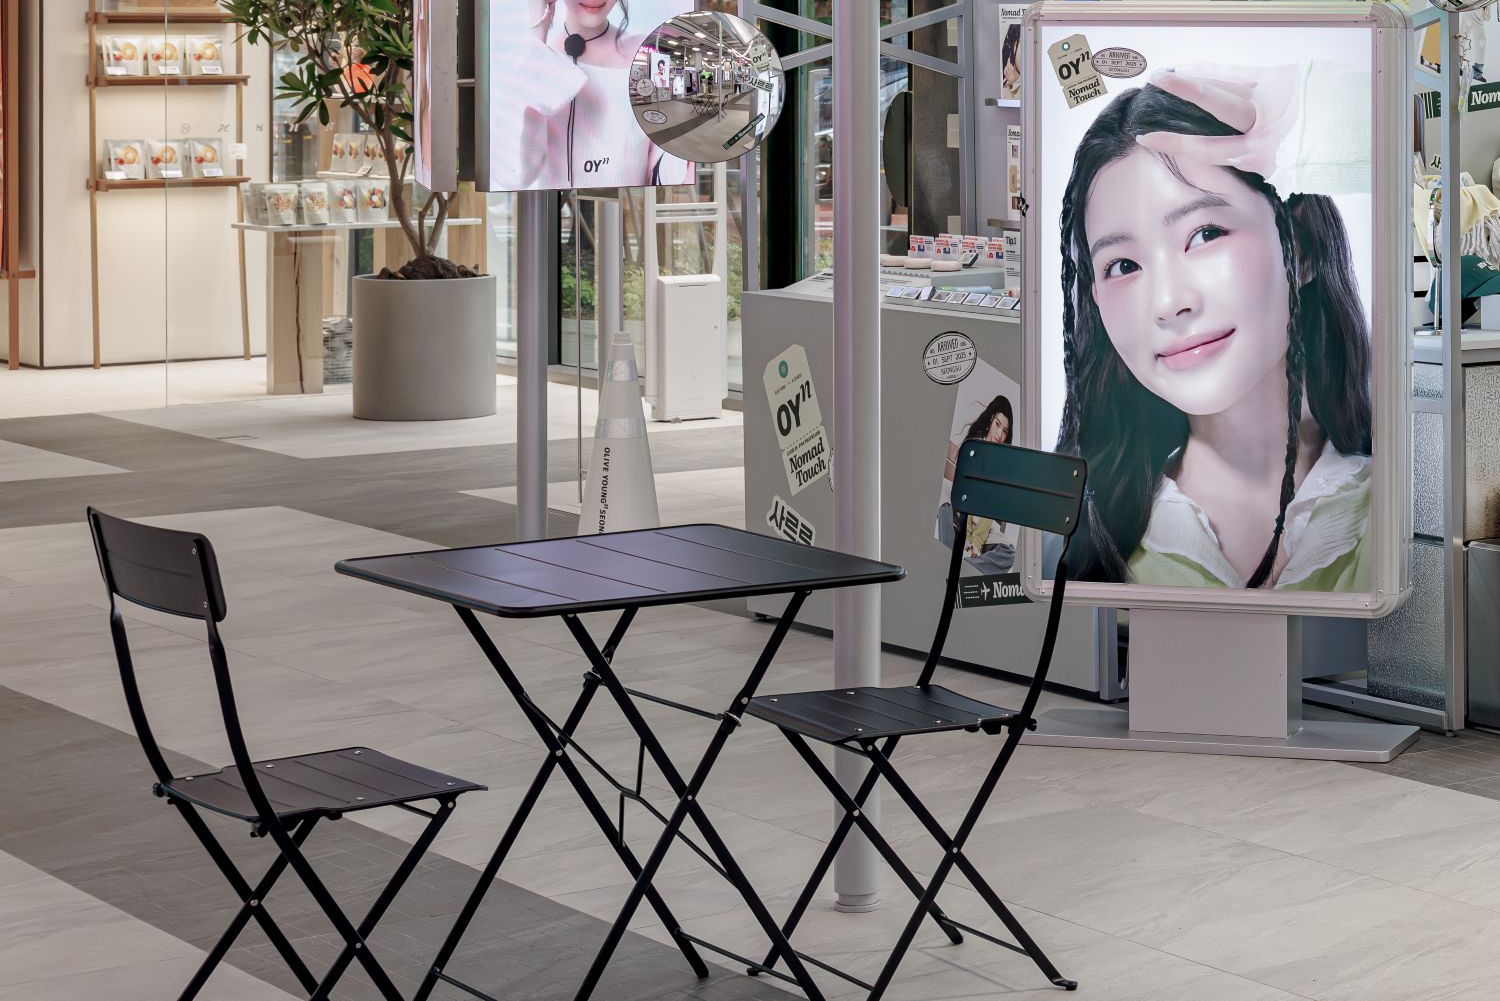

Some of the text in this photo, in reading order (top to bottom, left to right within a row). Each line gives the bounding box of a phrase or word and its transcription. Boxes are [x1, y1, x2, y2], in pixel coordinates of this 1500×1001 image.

[1068, 78, 1101, 98] Nomad
[1073, 89, 1102, 105] Touch
[602, 447, 610, 472] OLIVE
[788, 437, 825, 474] Nomad
[795, 457, 827, 488] Touch
